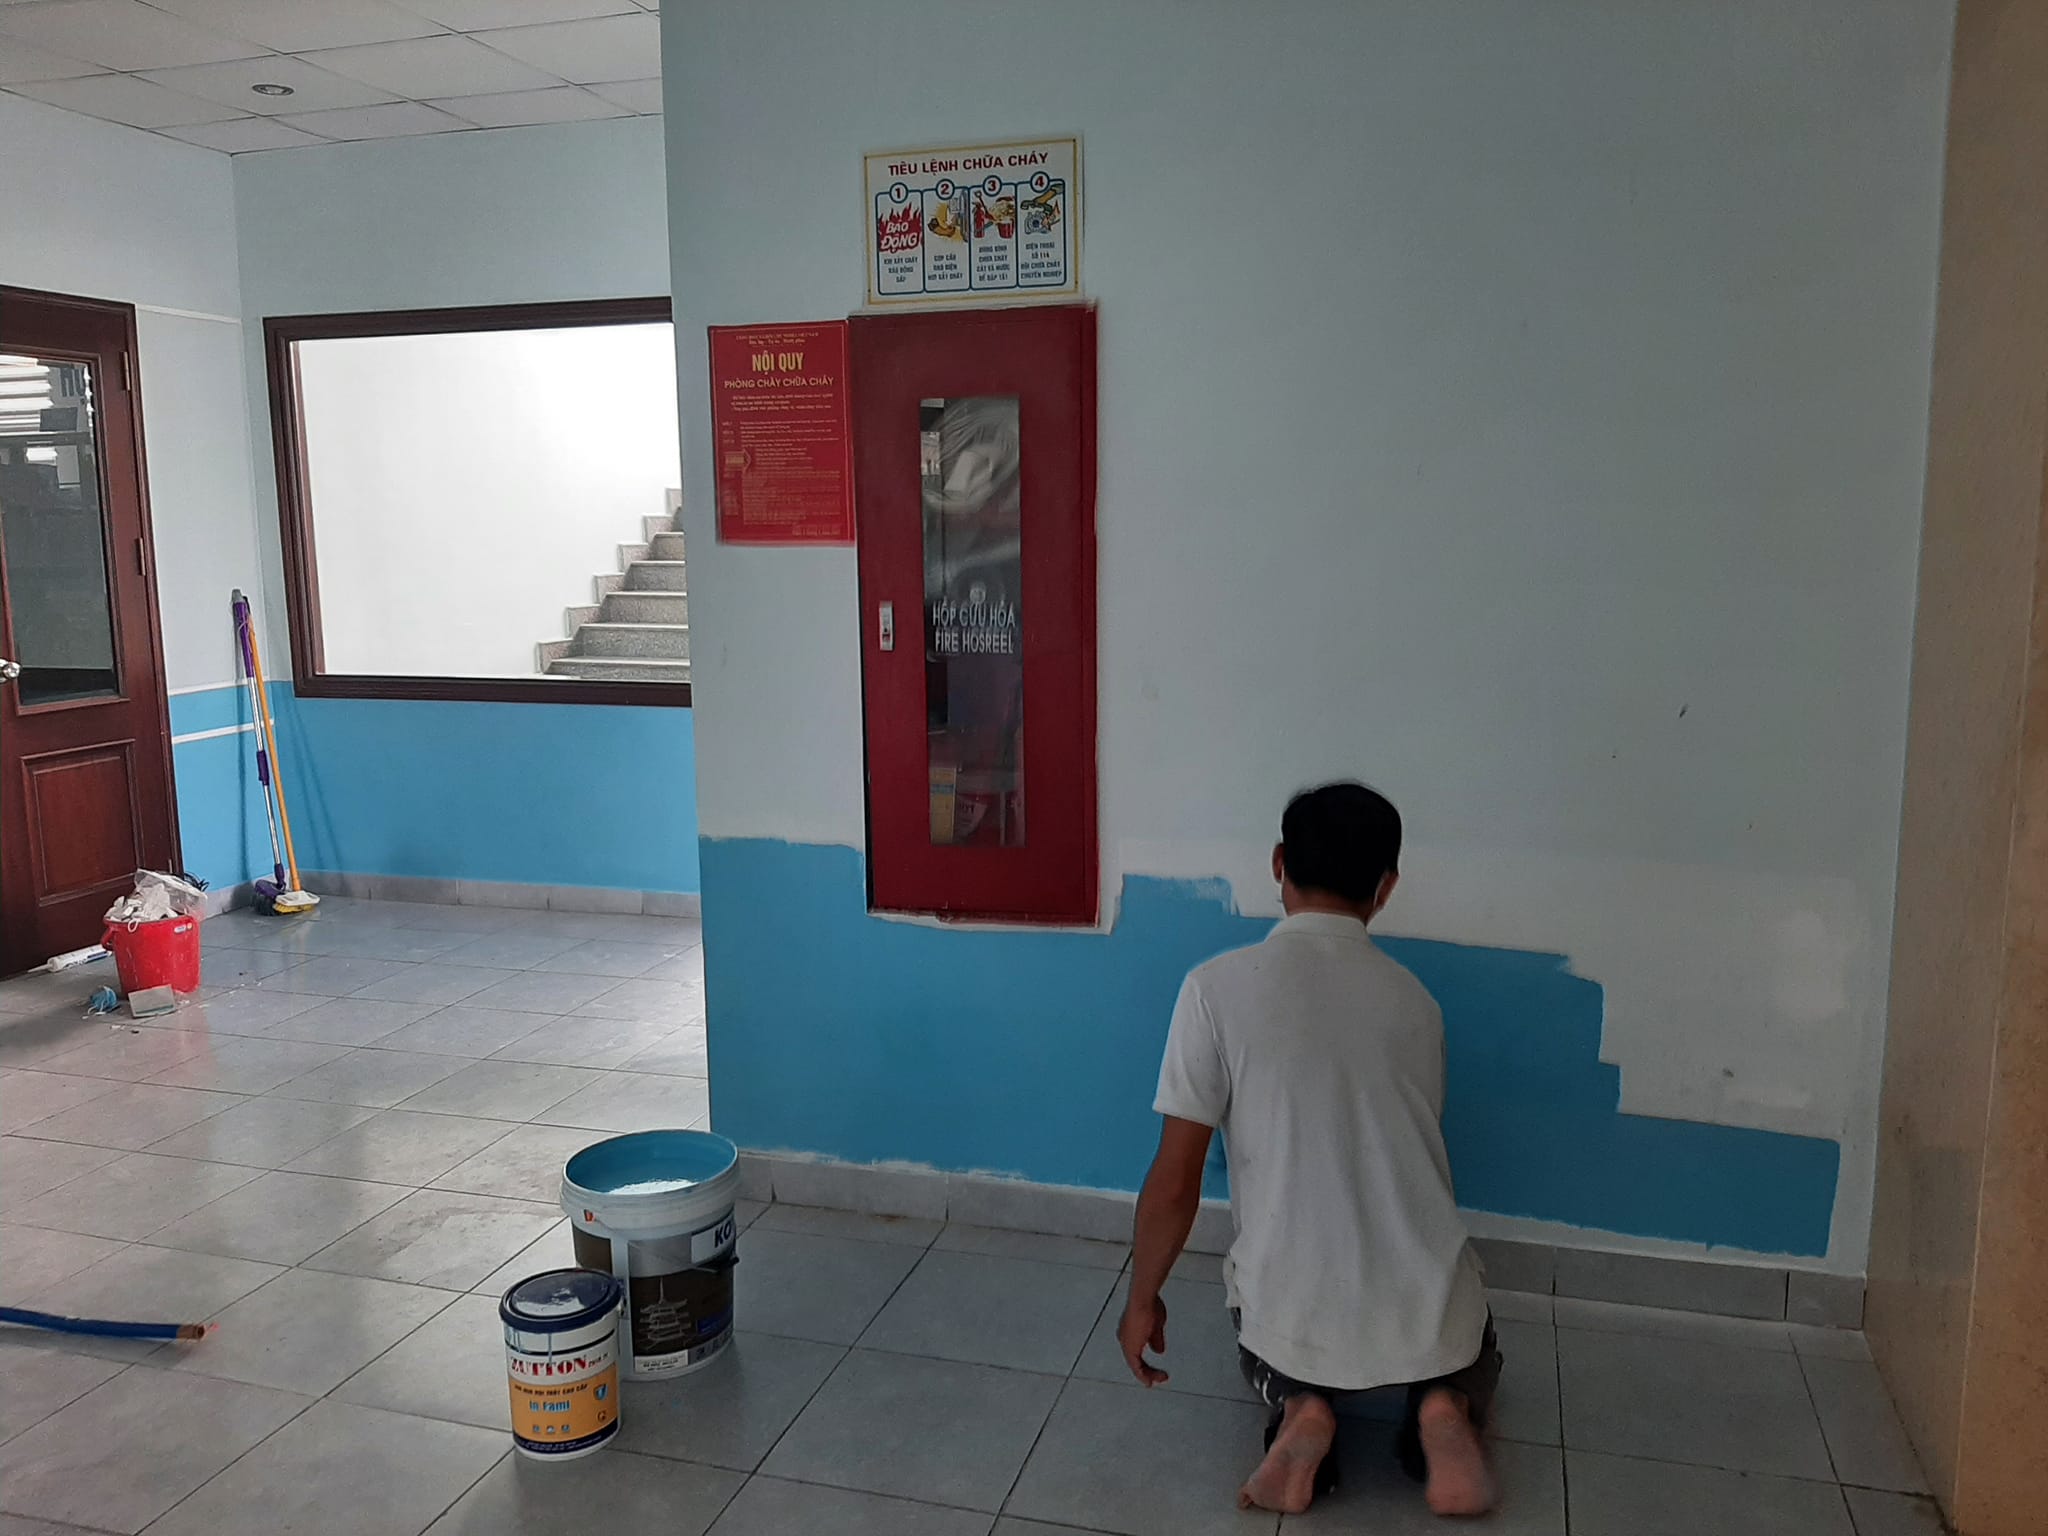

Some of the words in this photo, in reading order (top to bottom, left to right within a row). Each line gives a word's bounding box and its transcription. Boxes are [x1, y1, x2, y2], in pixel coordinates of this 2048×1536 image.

[888, 161, 918, 176] TIÊU
[922, 158, 958, 175] LỆNH
[963, 154, 1003, 169] CHỮA
[1008, 150, 1048, 166] CHÁY
[988, 180, 996, 192] 3
[1034, 176, 1044, 187] 4
[895, 188, 901, 198] 1
[940, 184, 950, 194] 2
[752, 350, 774, 375] NỘI
[778, 352, 804, 372] QUY
[724, 377, 755, 389] PHÒNG
[782, 375, 808, 386] CHỮA
[809, 374, 834, 386] CHÁY
[935, 629, 959, 653] FIRE
[962, 628, 1014, 653] HOSREEL
